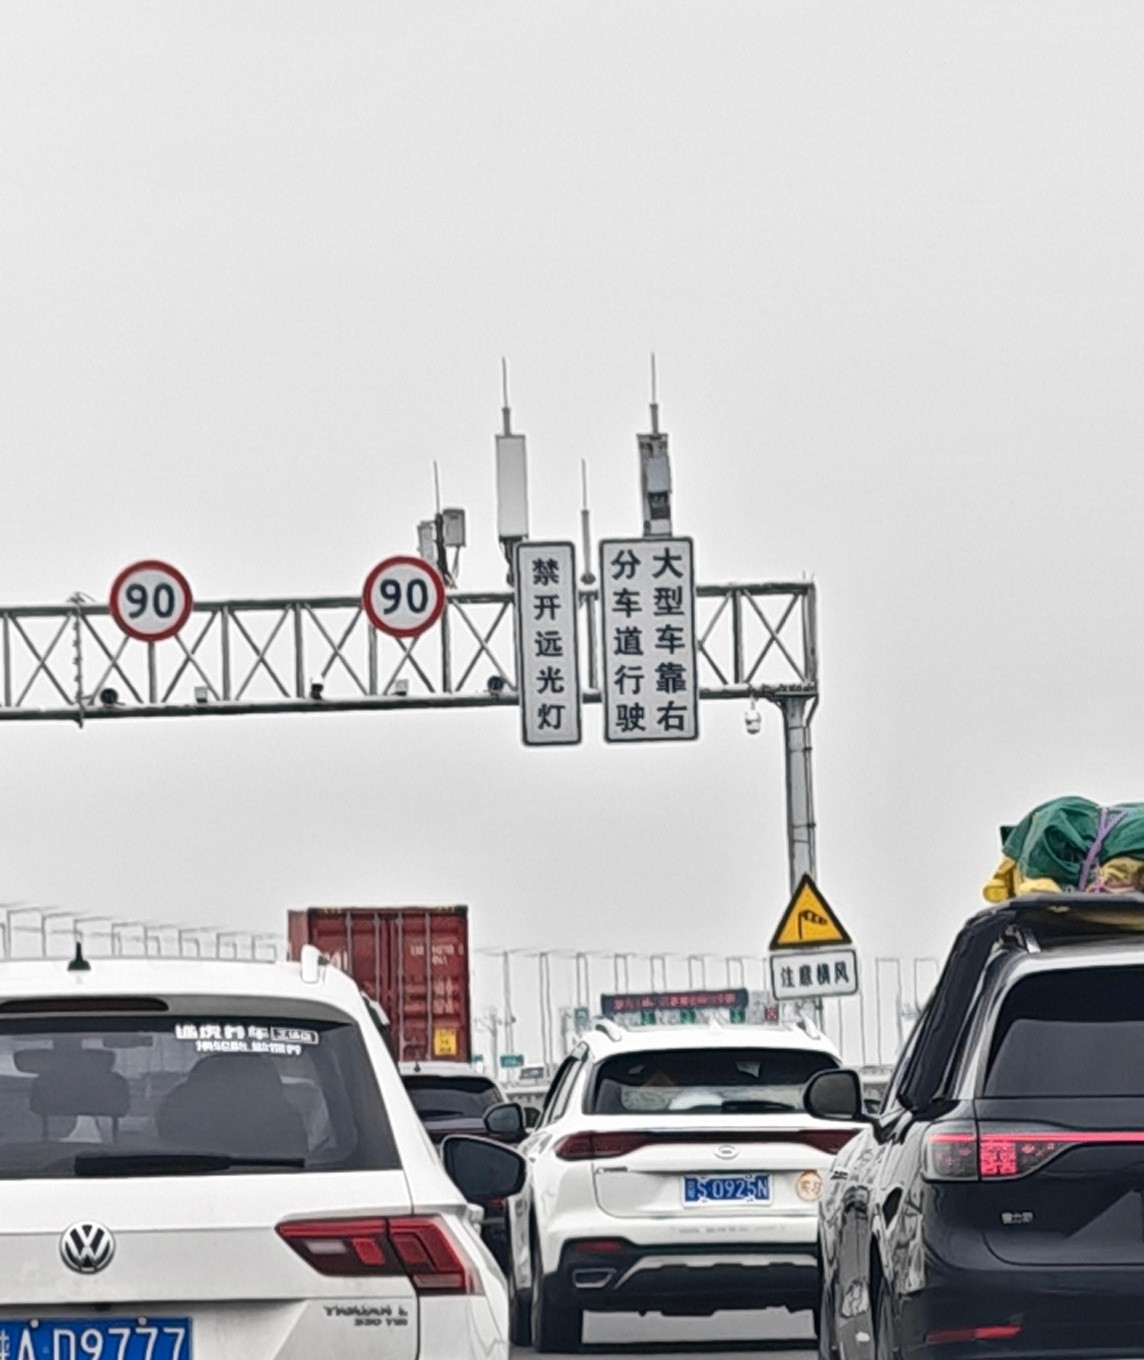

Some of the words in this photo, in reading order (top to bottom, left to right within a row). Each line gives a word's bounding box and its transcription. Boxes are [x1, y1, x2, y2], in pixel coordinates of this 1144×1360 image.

[124, 581, 176, 619] 90
[378, 577, 430, 616] 90
[532, 557, 566, 731] 禁开远光灯
[610, 549, 646, 733] 分车道行驶
[652, 547, 688, 732] 大型车靠右
